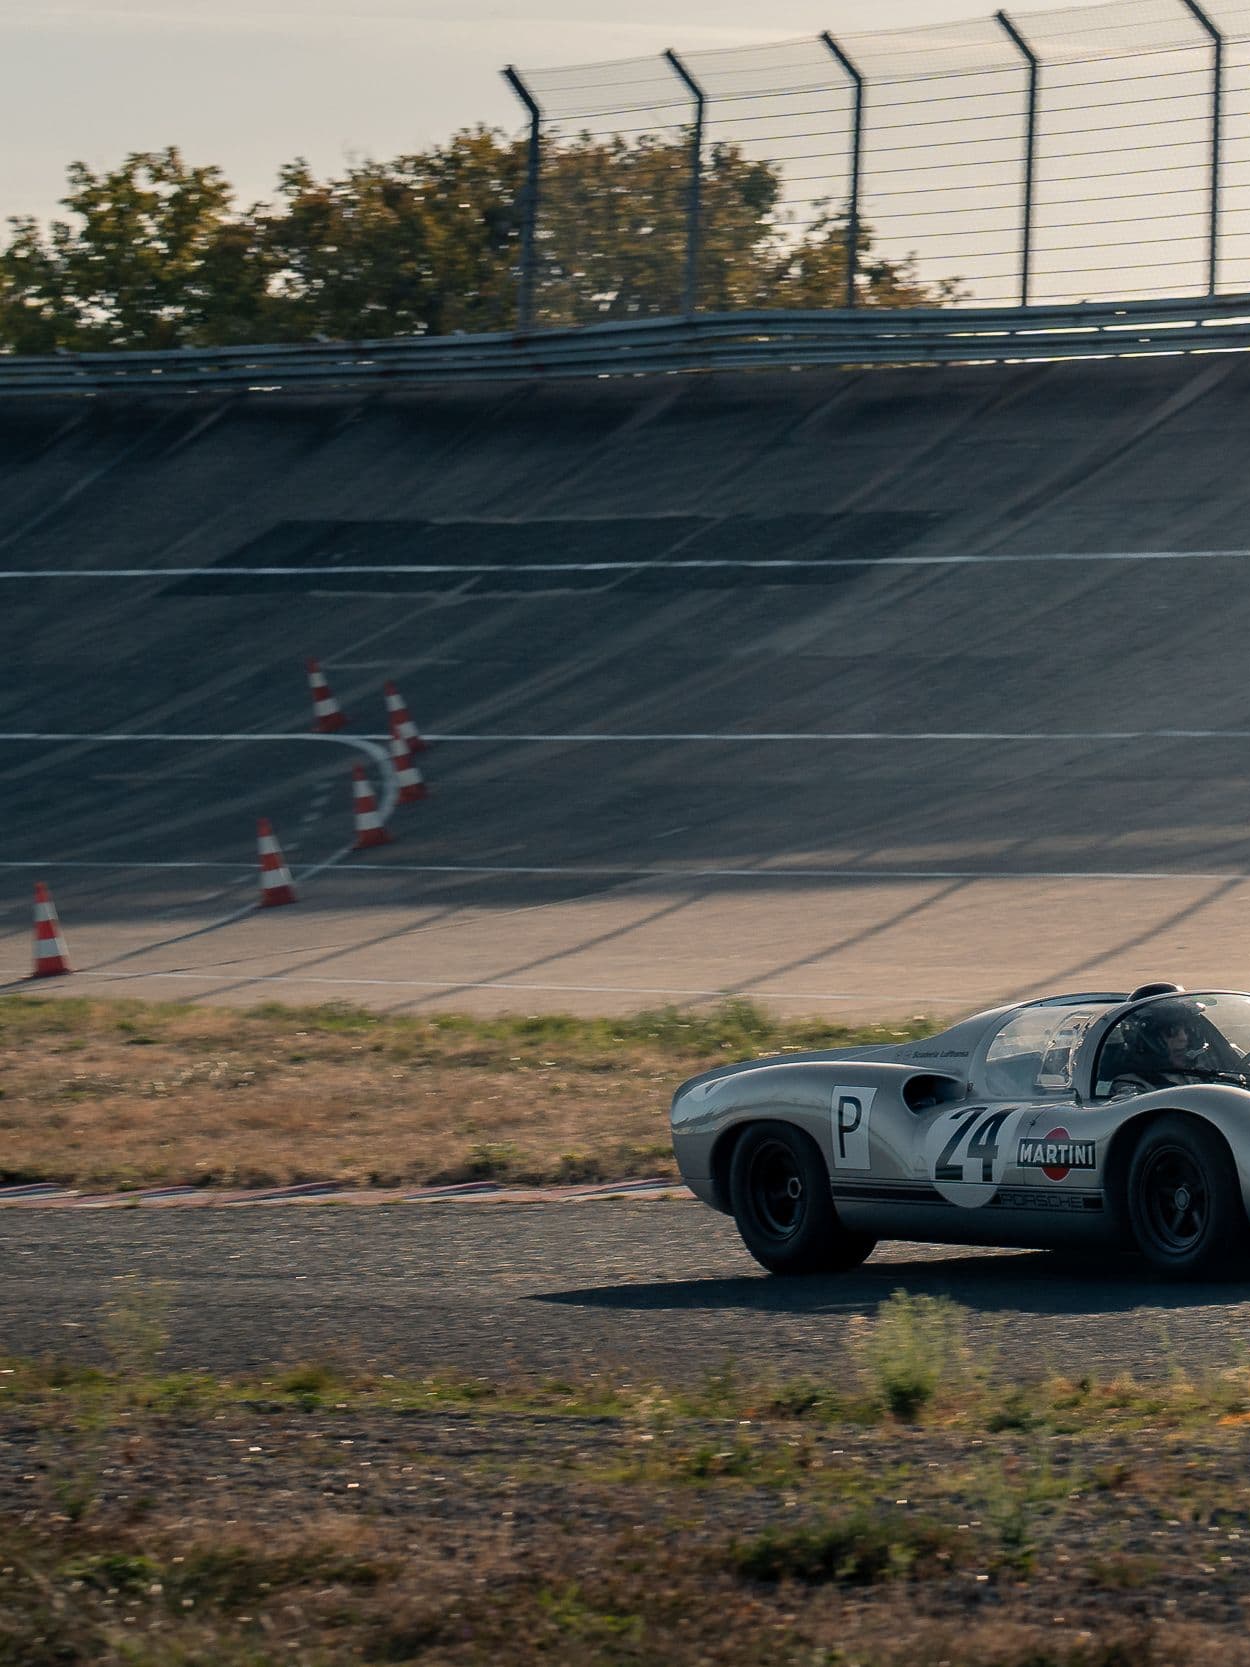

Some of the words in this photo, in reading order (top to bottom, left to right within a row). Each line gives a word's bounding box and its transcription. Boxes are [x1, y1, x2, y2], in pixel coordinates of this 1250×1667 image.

[837, 1096, 861, 1159] P
[934, 1106, 1020, 1183] 24
[1020, 1143, 1094, 1165] MARTINI
[1001, 1193, 1082, 1208] PORSCHE
